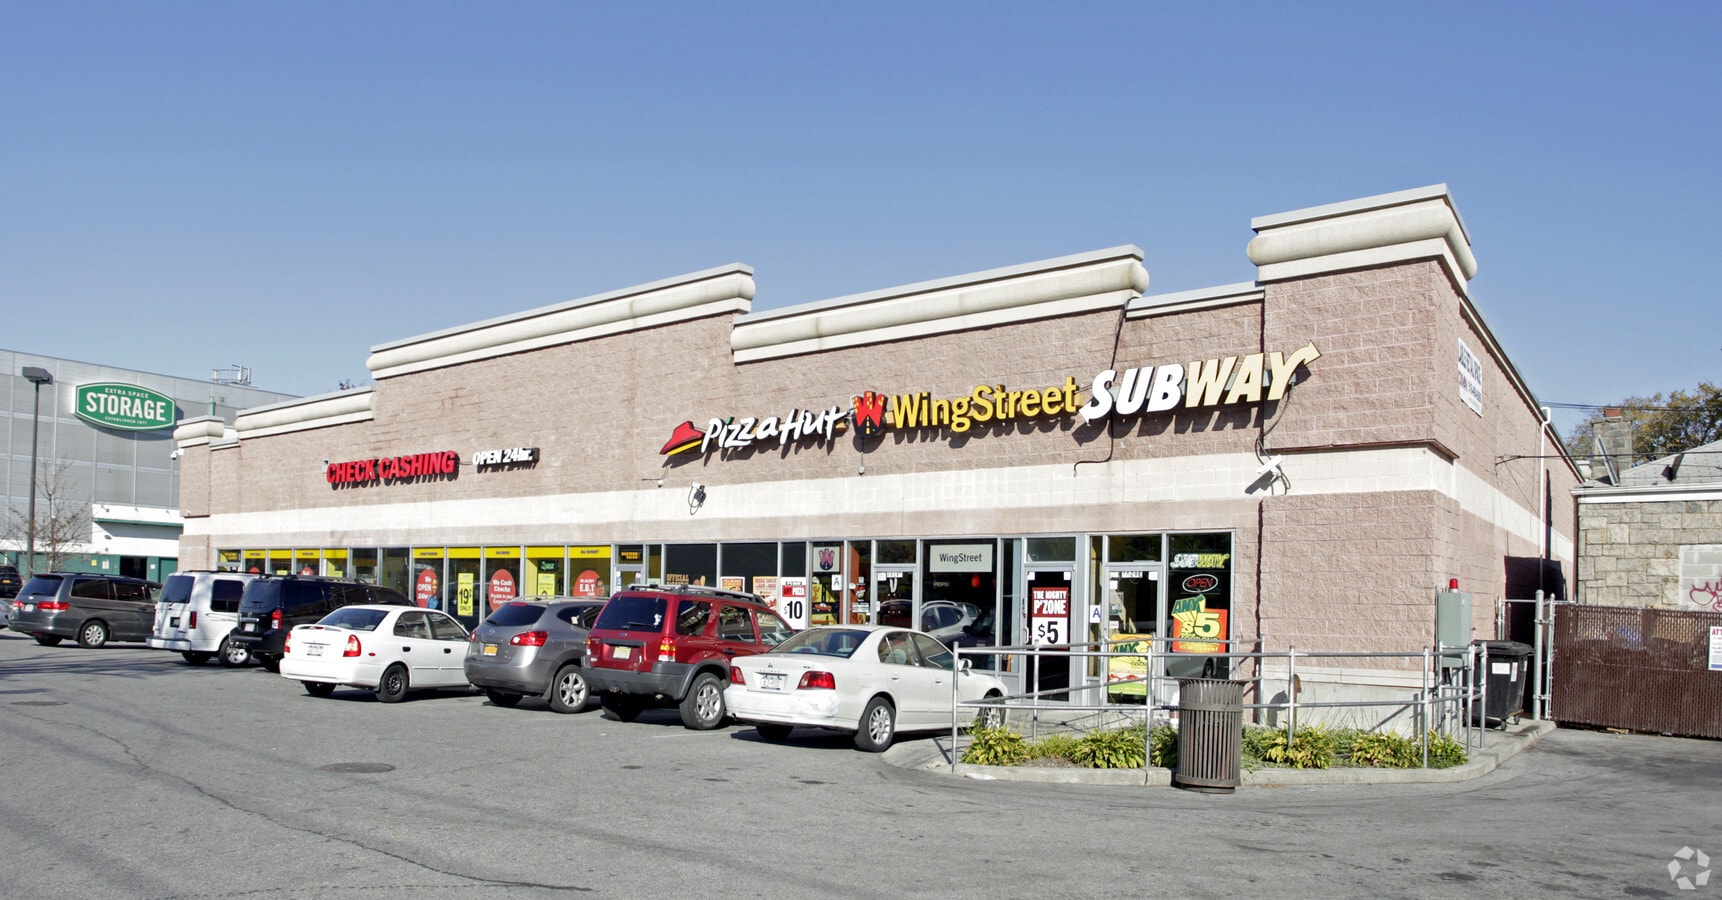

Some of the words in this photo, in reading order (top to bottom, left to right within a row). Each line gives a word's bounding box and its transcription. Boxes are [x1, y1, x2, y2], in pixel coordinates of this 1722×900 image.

[1079, 341, 1321, 424] SUBWAY
[104, 387, 126, 396] EXTRA
[127, 390, 149, 399] SPACE
[86, 392, 166, 421] STORAGE
[892, 376, 1077, 433] WingStreet
[701, 417, 778, 453] Pizza
[775, 405, 847, 445] Hut
[326, 458, 376, 483] CHECK
[378, 450, 456, 479] CASHING
[472, 450, 501, 465] OPEN
[939, 552, 983, 564] WingStreet
[1170, 553, 1230, 569] SUBWAY
[833, 576, 840, 586] A
[1187, 577, 1214, 588] OPEN
[1033, 590, 1045, 600] THE
[1045, 590, 1067, 600] MIGHTY
[784, 600, 803, 620] $10
[1034, 600, 1067, 615] P'ZONE
[1092, 607, 1102, 619] A
[1171, 595, 1205, 615] ANY
[1038, 620, 1059, 645] $5
[1181, 611, 1221, 638] $5
